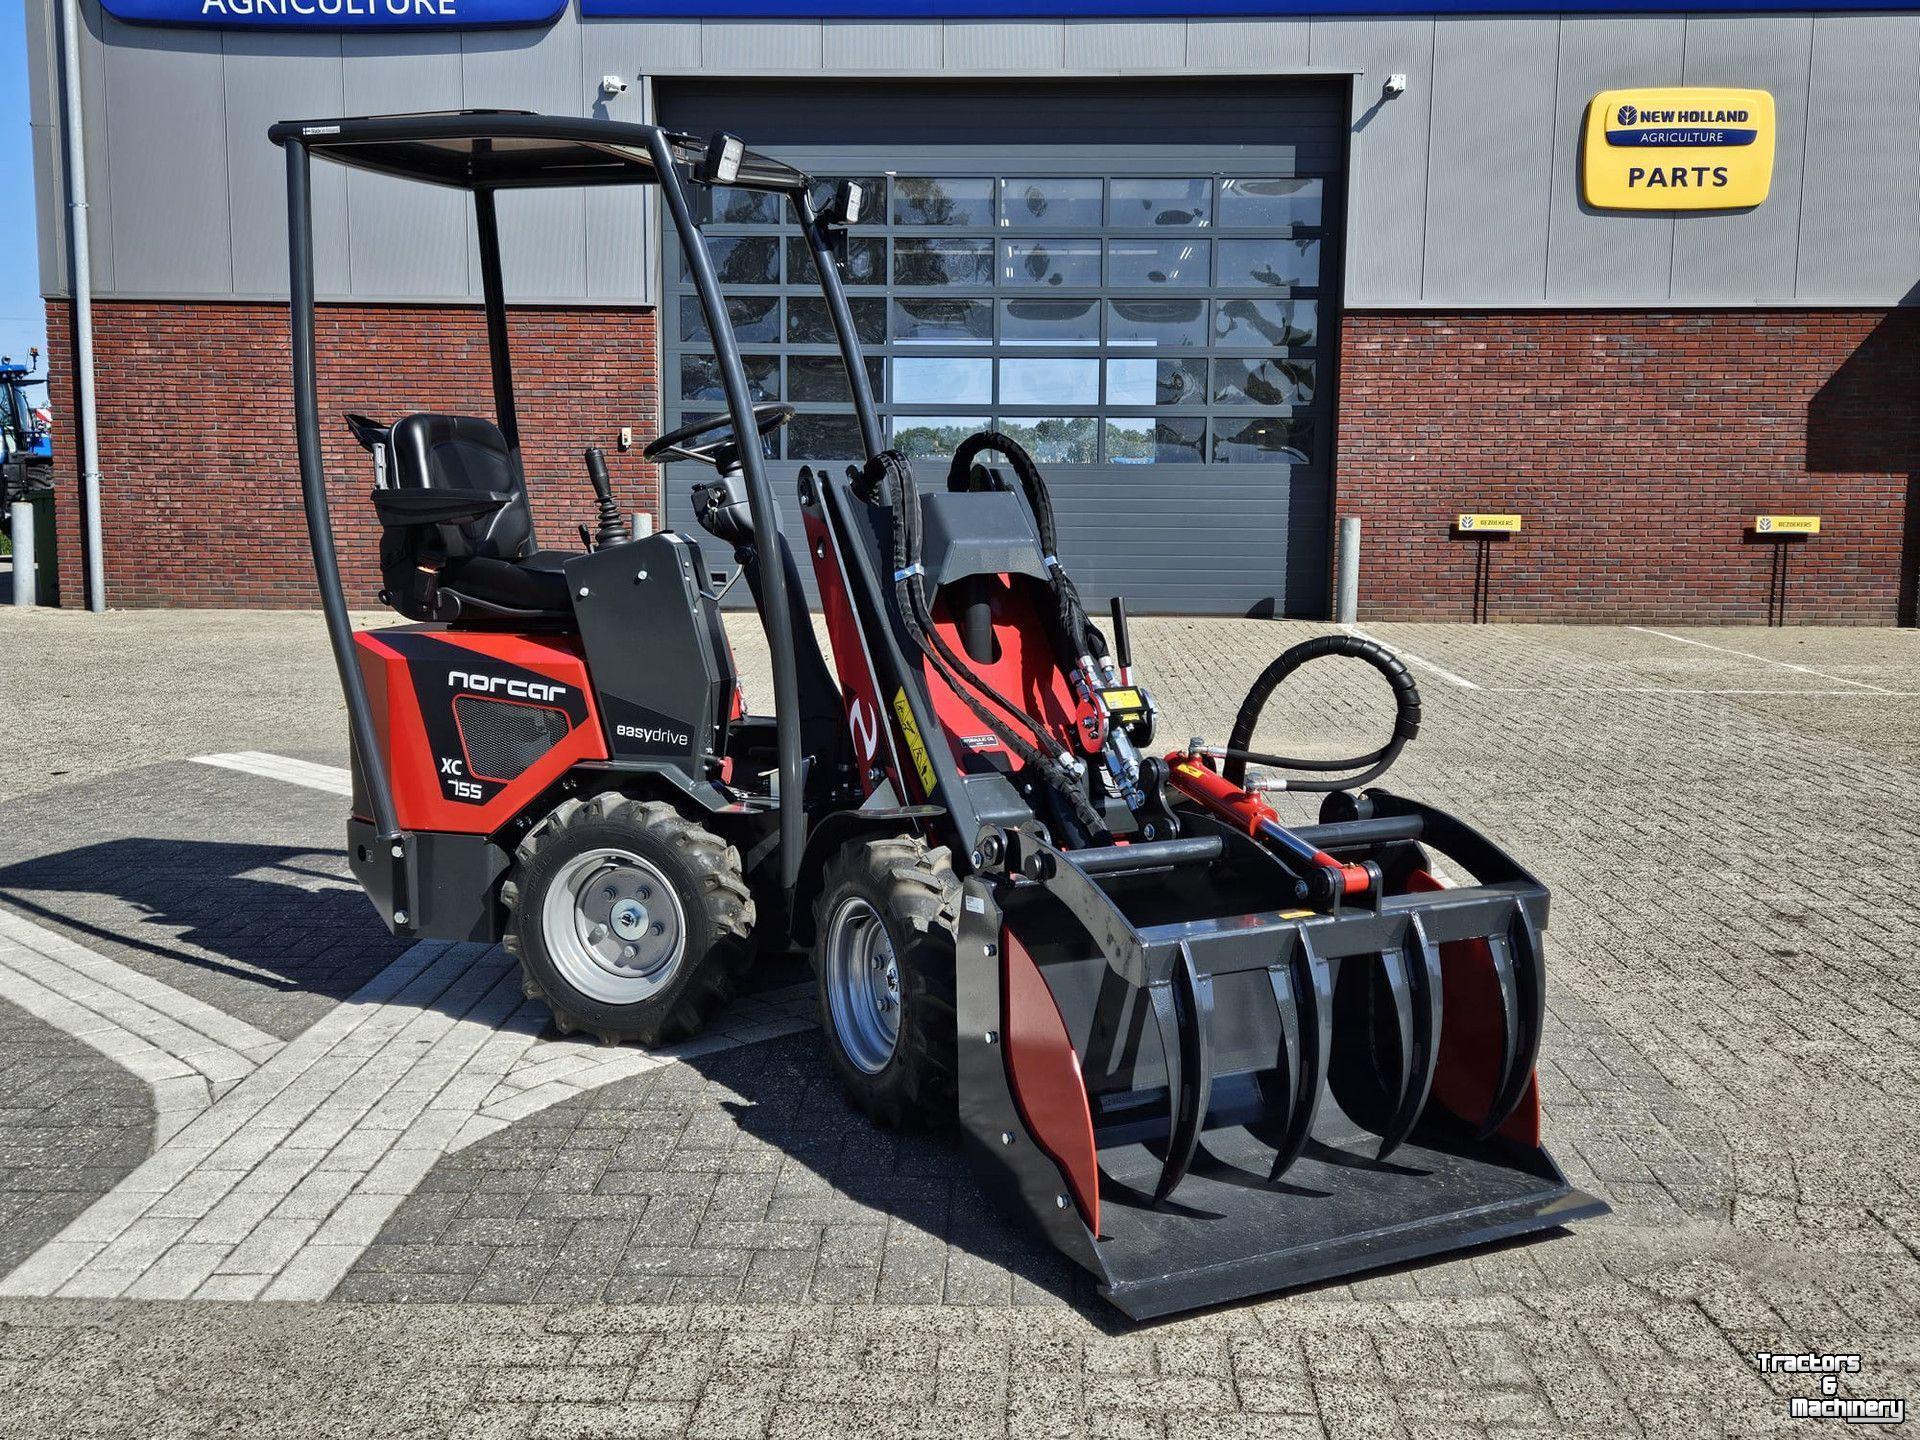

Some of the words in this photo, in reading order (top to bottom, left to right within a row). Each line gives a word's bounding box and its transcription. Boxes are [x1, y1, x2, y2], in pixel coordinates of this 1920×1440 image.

[1640, 110, 1675, 123] NEW
[1677, 110, 1749, 123] HOLLAND
[1640, 132, 1724, 143] AGRICULTURE
[1628, 166, 1729, 188] PARTS
[448, 670, 566, 702] norcar
[616, 724, 688, 746] easydrive
[440, 757, 463, 776] XC
[447, 779, 483, 800] 755
